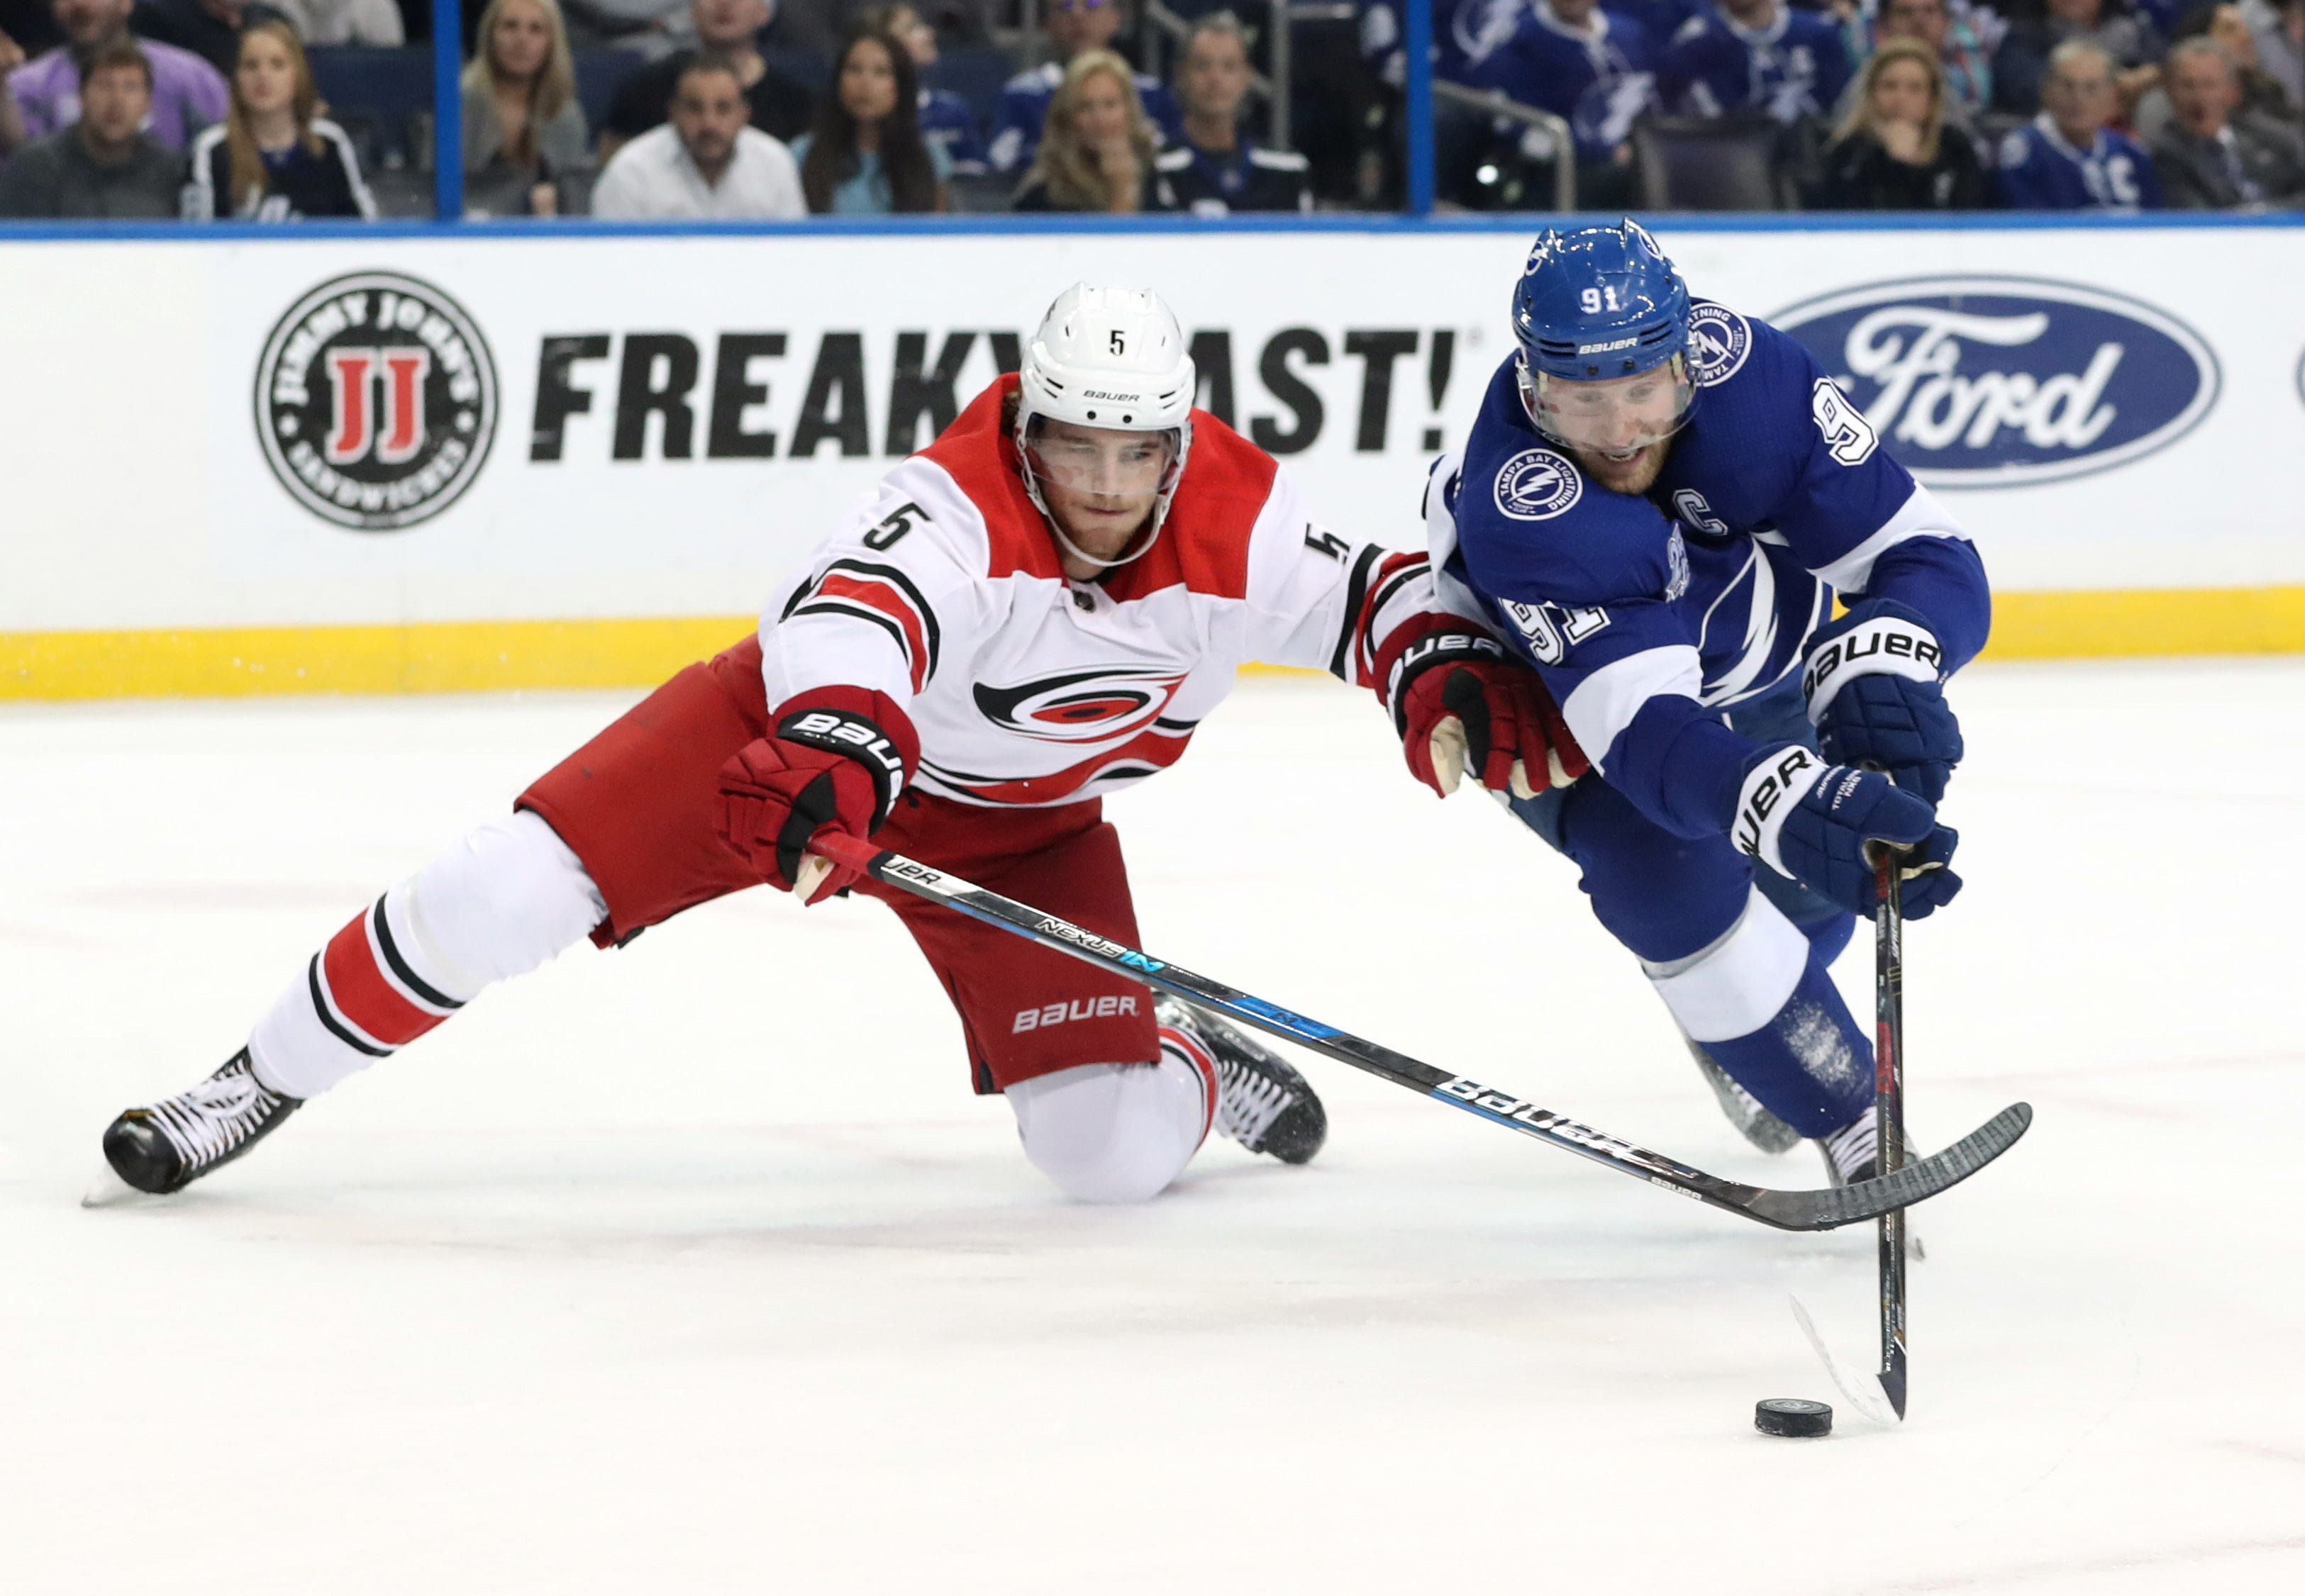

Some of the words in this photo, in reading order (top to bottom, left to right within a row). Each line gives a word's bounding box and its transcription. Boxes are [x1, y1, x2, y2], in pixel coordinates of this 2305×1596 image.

[1581, 286, 1620, 314] 91
[1110, 330, 1125, 356] 5
[1578, 337, 1638, 355] BAUER
[529, 330, 1023, 462] FREAK
[1083, 390, 1140, 402] BAUER
[1837, 306, 2123, 450] Ford
[326, 346, 430, 464] JJ
[1500, 462, 1524, 497] TAMPA
[1526, 455, 1552, 464] BAY
[1548, 461, 1576, 510] LIGHTNING
[863, 502, 932, 551] 5
[1672, 489, 1728, 536] C
[1498, 598, 1611, 665] 91
[1035, 919, 1128, 958] NEXUS
[1012, 995, 1137, 1034] BAUER
[1650, 1176, 1702, 1201] BAUER
